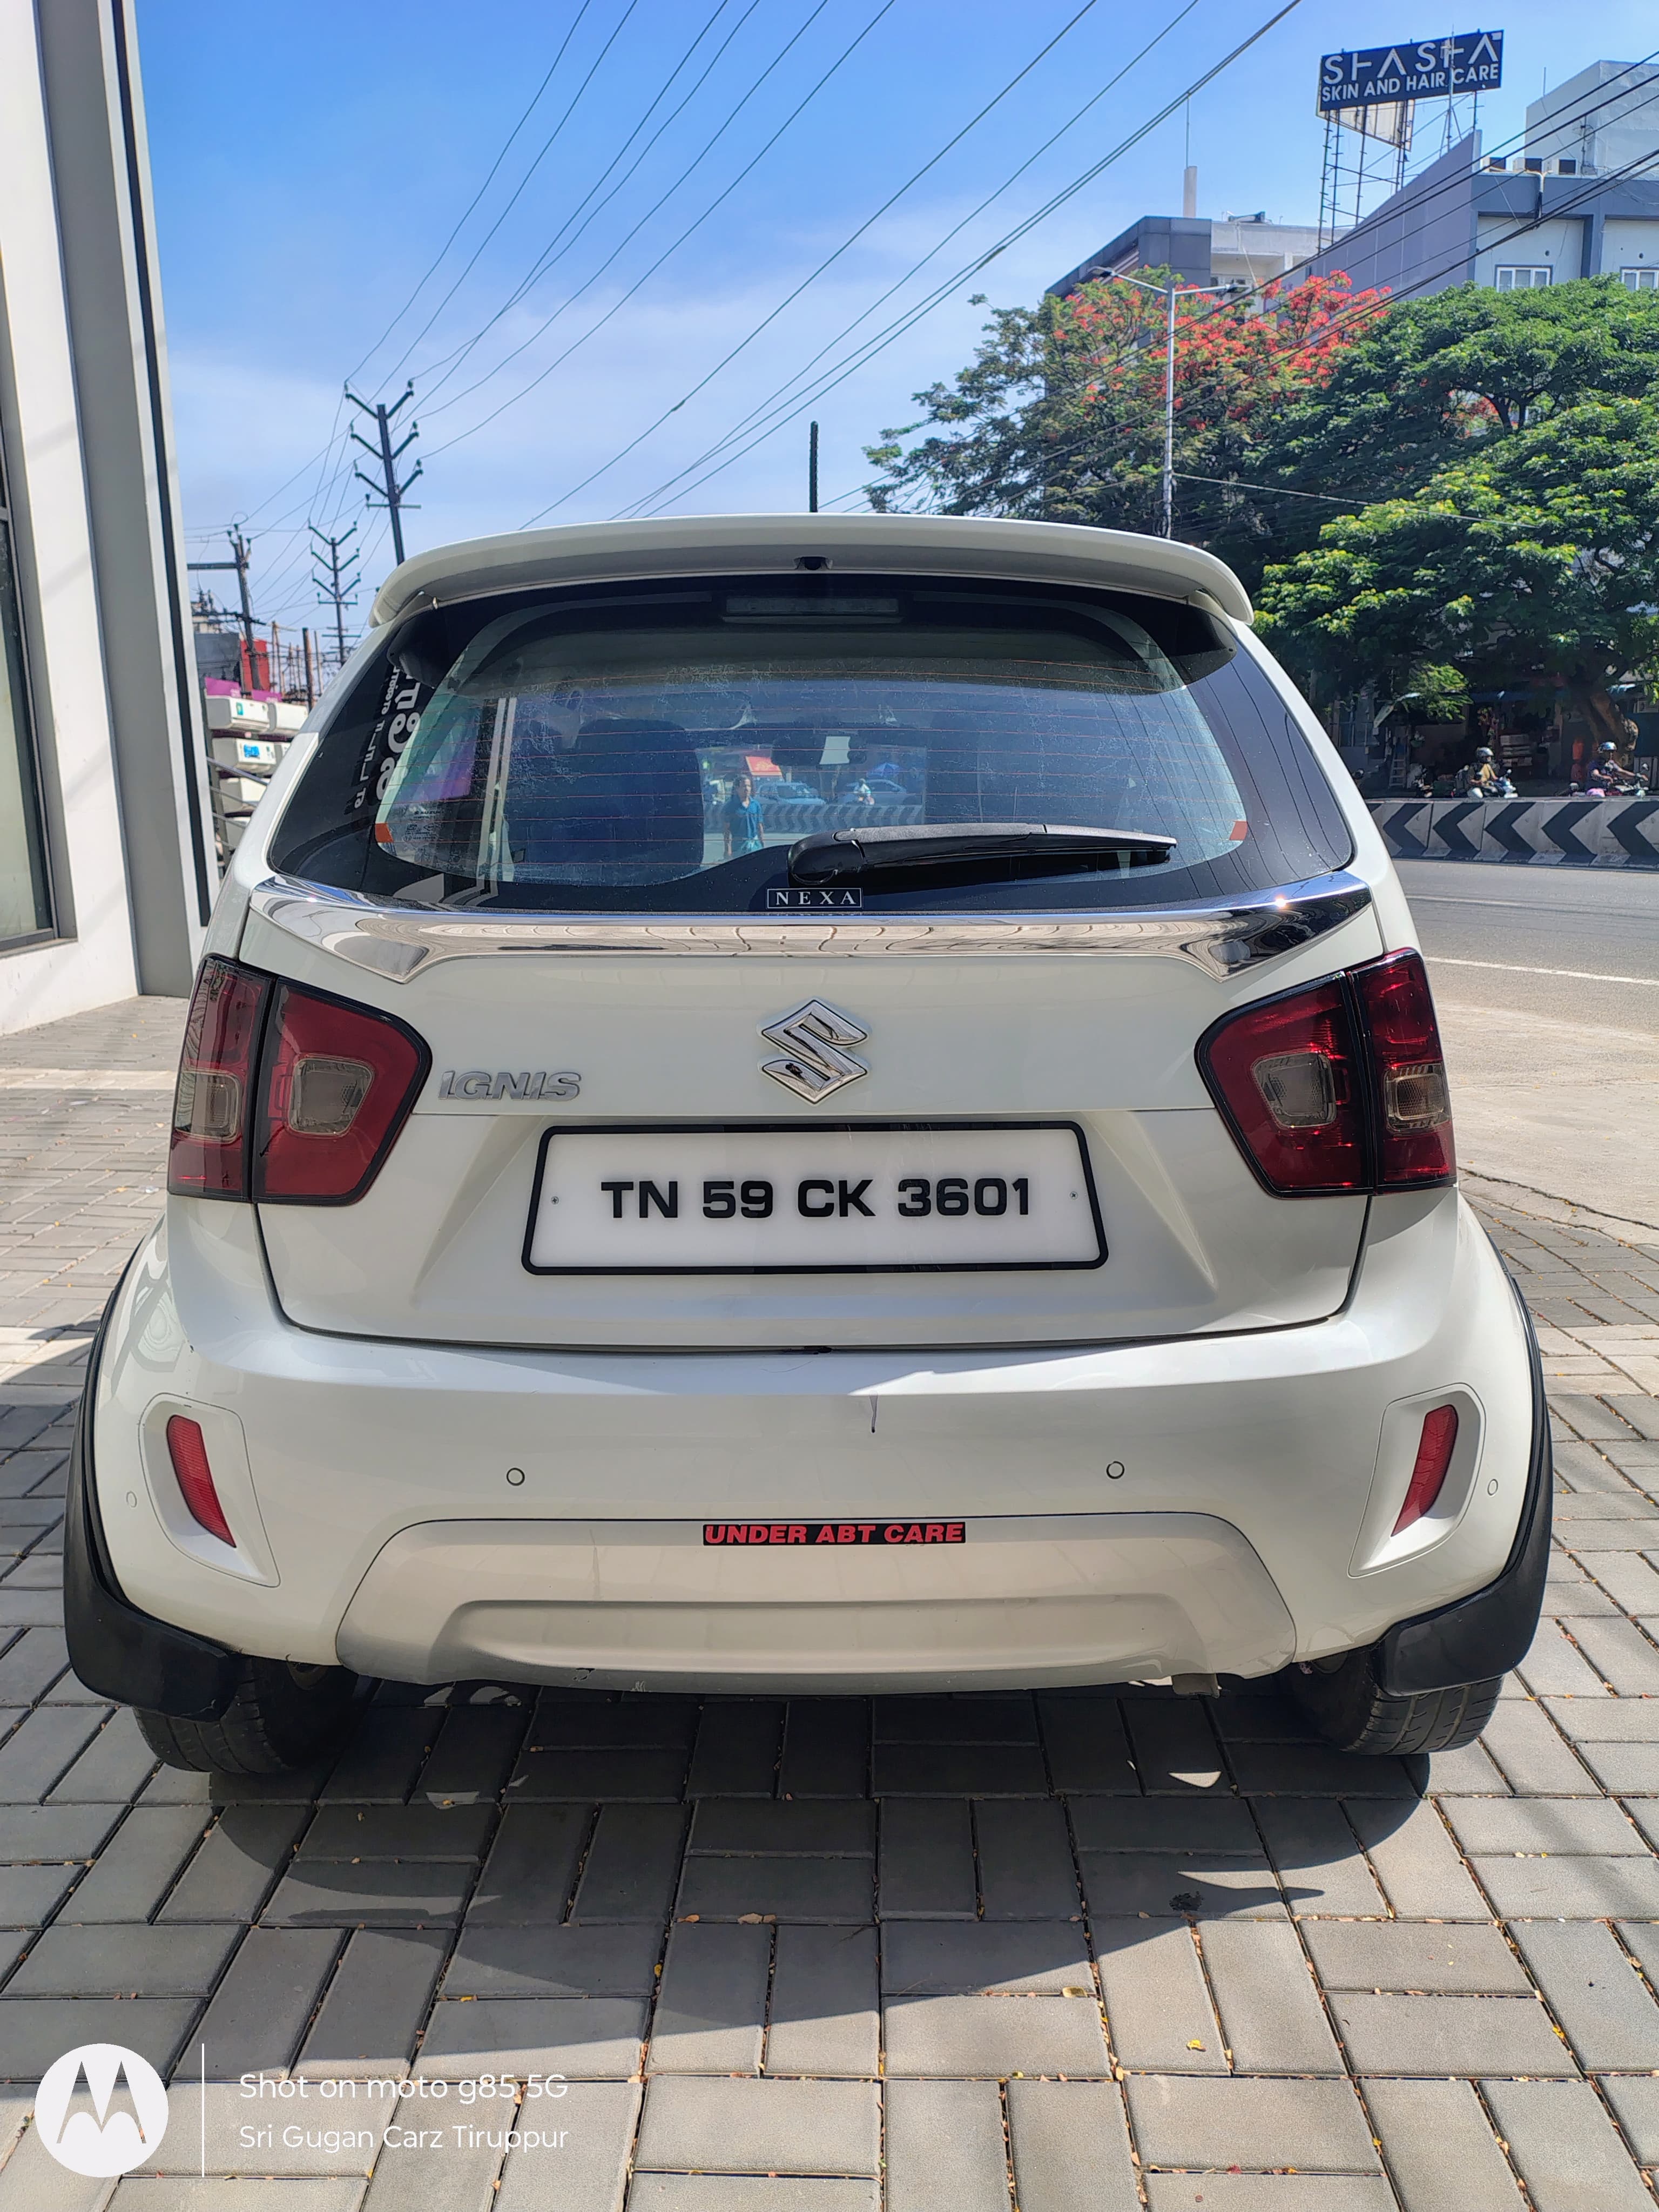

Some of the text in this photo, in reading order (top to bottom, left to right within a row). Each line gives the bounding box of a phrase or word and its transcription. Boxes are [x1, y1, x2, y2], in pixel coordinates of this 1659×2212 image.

[1321, 64, 1499, 102] SKIN AND HAIR CARE
[775, 891, 857, 905] NEXA
[438, 1070, 582, 1102] IGNIS
[601, 1178, 1029, 1219] TN 59 CK 3601
[705, 1524, 963, 1543] UNDER ABT CARE
